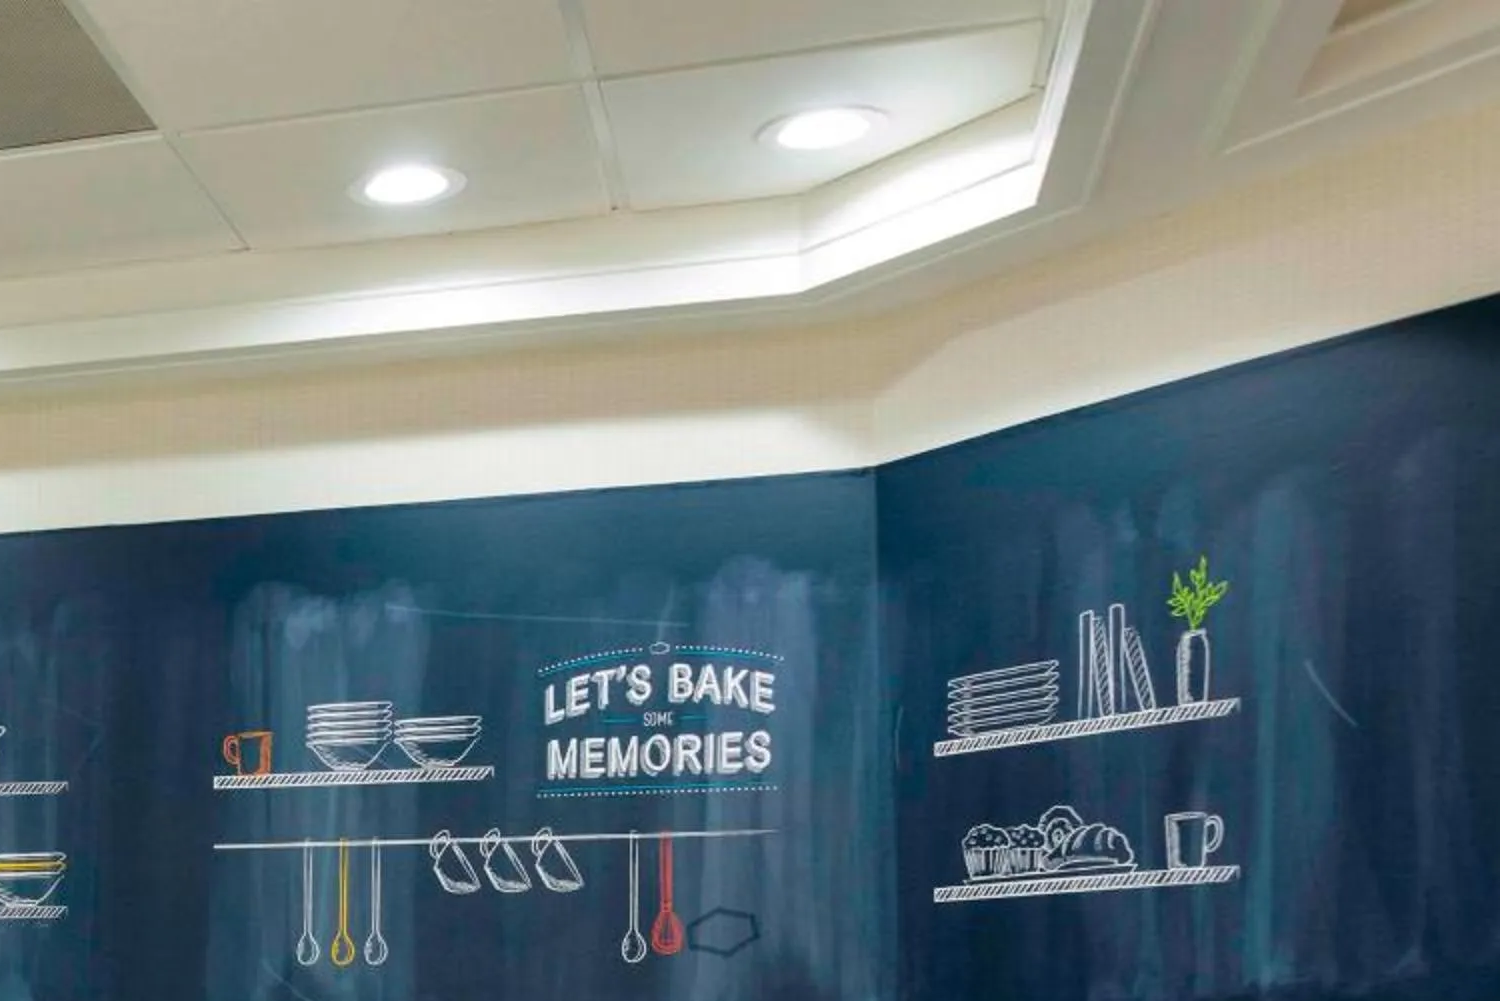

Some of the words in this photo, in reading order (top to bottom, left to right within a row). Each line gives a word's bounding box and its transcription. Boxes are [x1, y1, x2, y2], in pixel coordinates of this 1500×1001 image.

[668, 663, 776, 714] BAKE
[642, 710, 673, 727] SOME
[547, 730, 772, 780] MEMORIES
